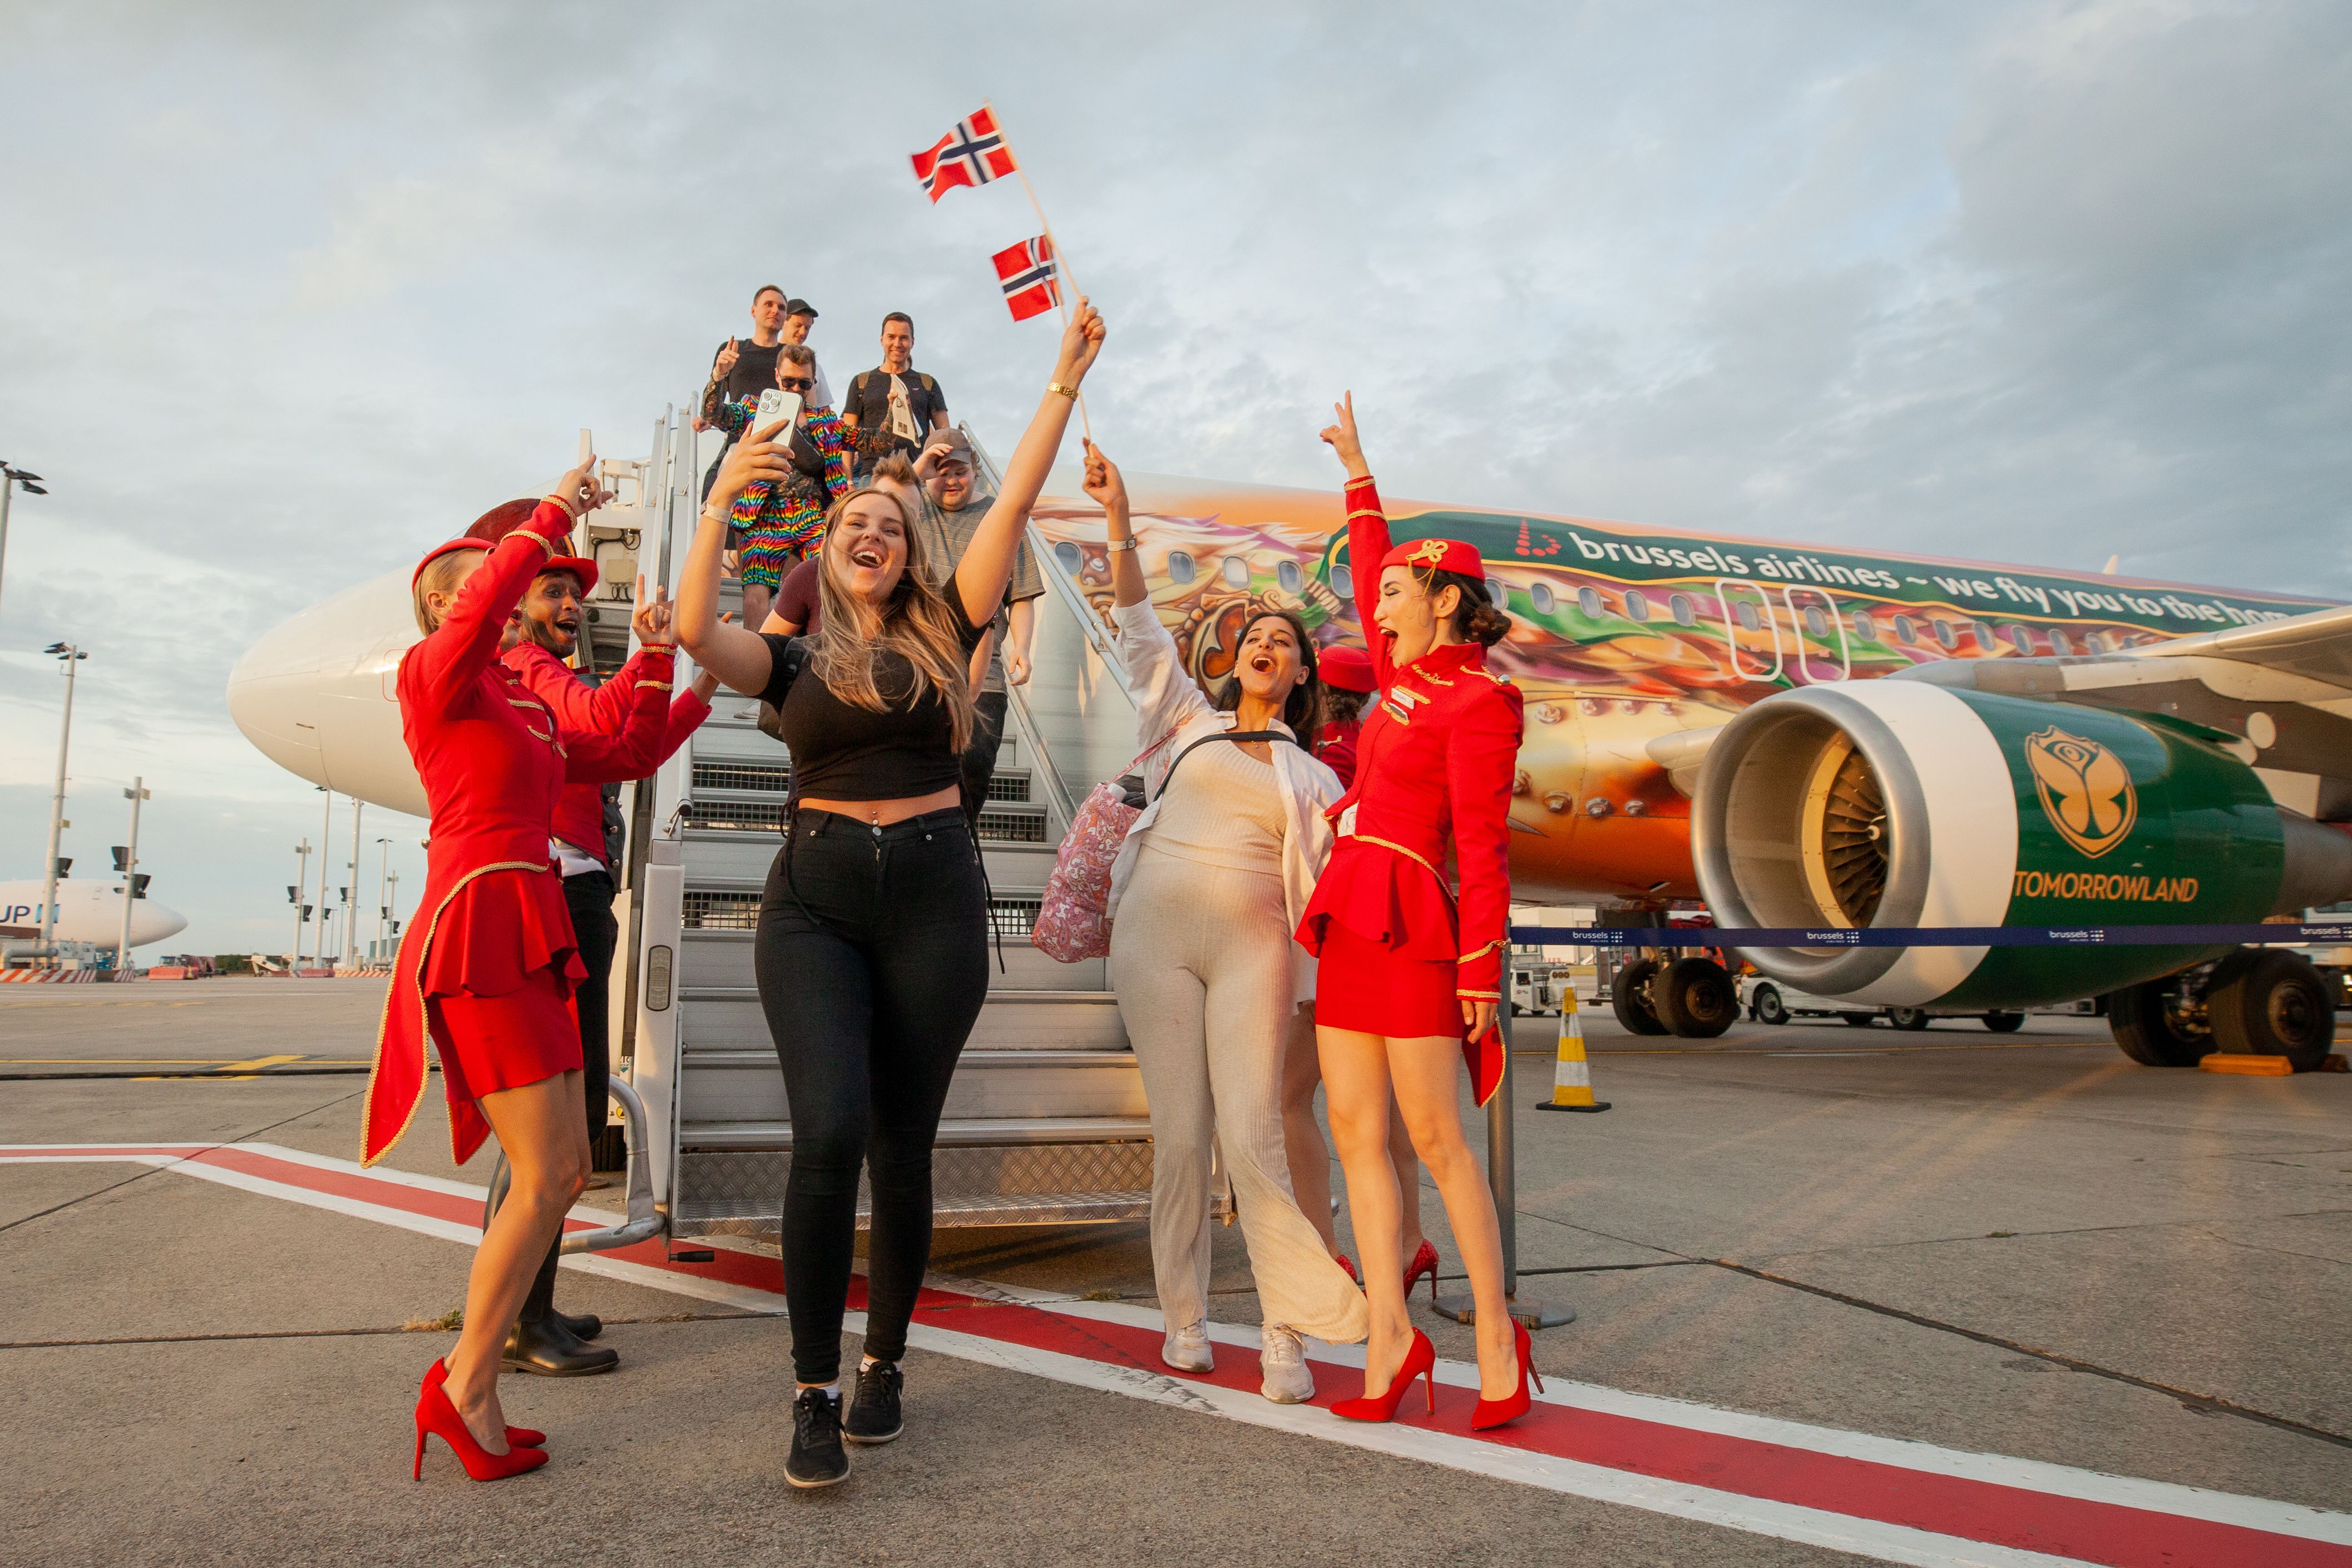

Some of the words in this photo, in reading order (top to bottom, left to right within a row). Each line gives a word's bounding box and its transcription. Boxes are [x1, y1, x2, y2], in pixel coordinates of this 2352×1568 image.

[1568, 531, 1750, 575] brussels
[1753, 553, 1900, 590] airlines
[1933, 576, 1999, 600] we
[1994, 576, 2052, 613] fly
[2049, 588, 2124, 616] you
[2118, 593, 2164, 617] to
[2158, 595, 2226, 622] the
[2015, 870, 2198, 903] TOMORROWLAND
